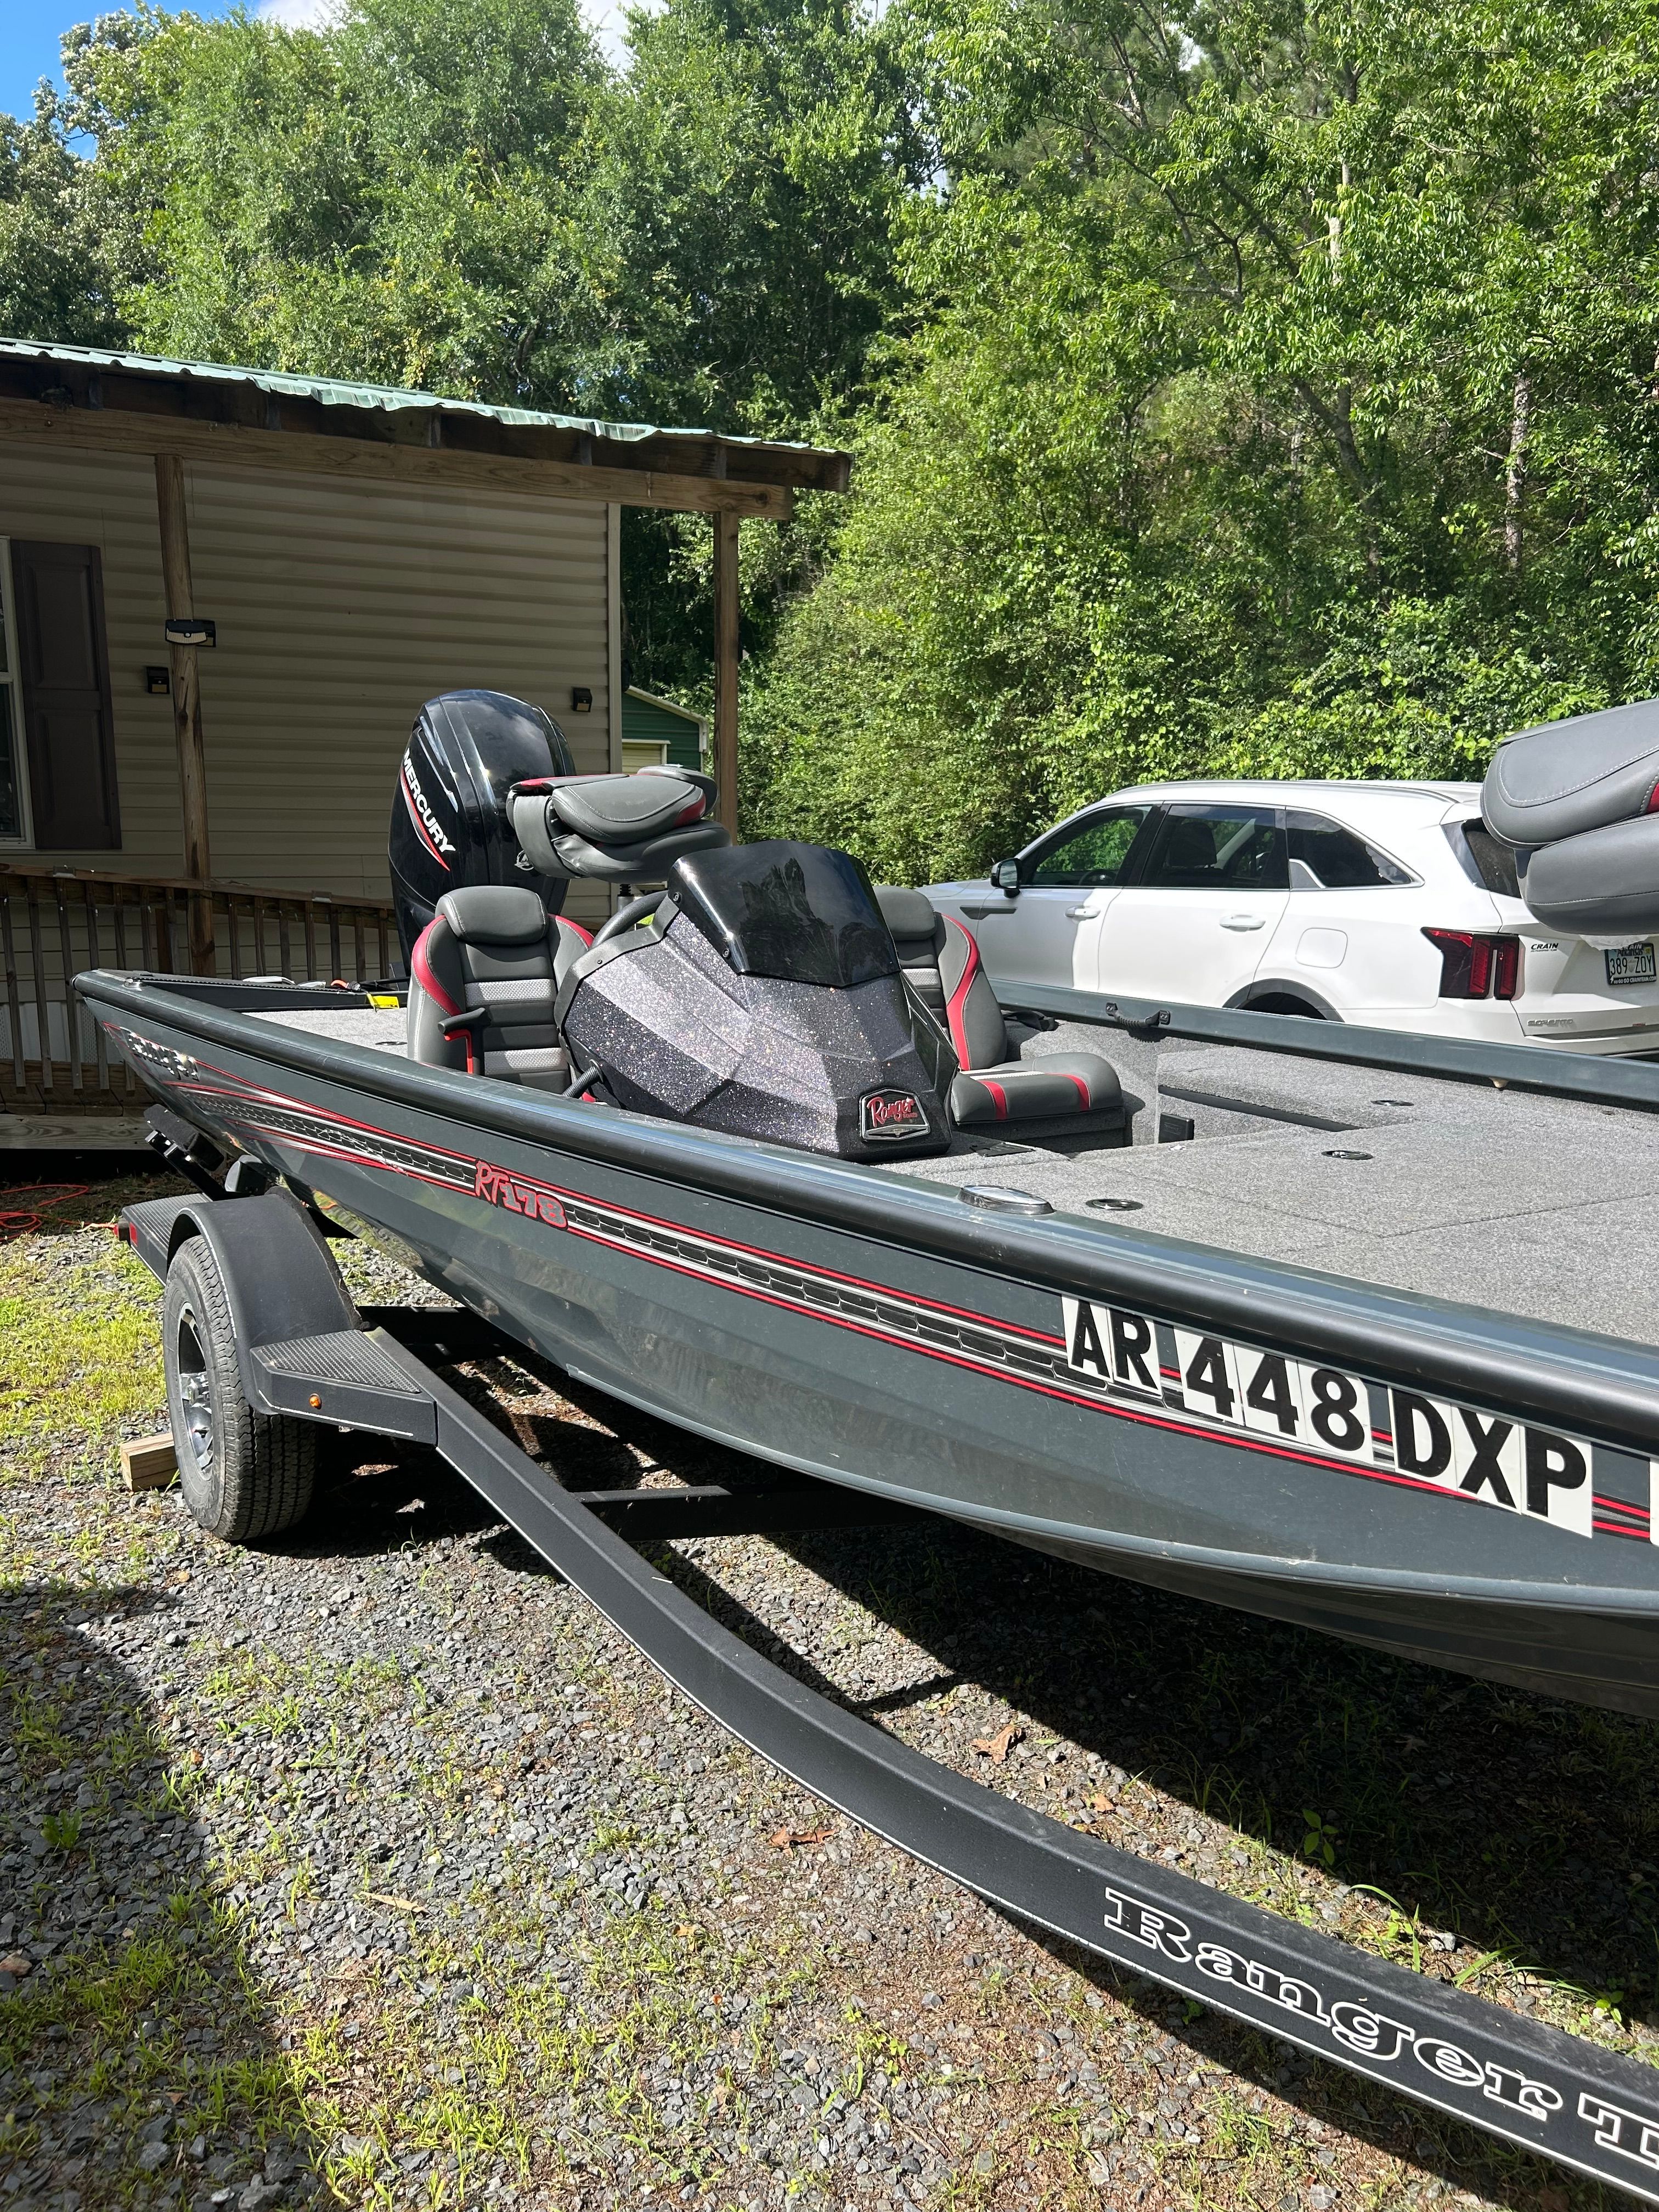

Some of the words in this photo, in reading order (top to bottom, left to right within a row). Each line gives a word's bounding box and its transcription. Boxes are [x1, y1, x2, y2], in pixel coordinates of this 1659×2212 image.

[404, 747, 456, 853] MERCURY
[1610, 957, 1628, 975] 389
[1634, 955, 1652, 974] ZOY
[866, 1096, 915, 1128] Ranger
[475, 1160, 567, 1228] RT178
[1071, 1300, 1158, 1390] AR
[1186, 1337, 1364, 1451] 448
[1391, 1389, 1587, 1517] DXP
[1104, 1886, 1564, 2123] Ranger
